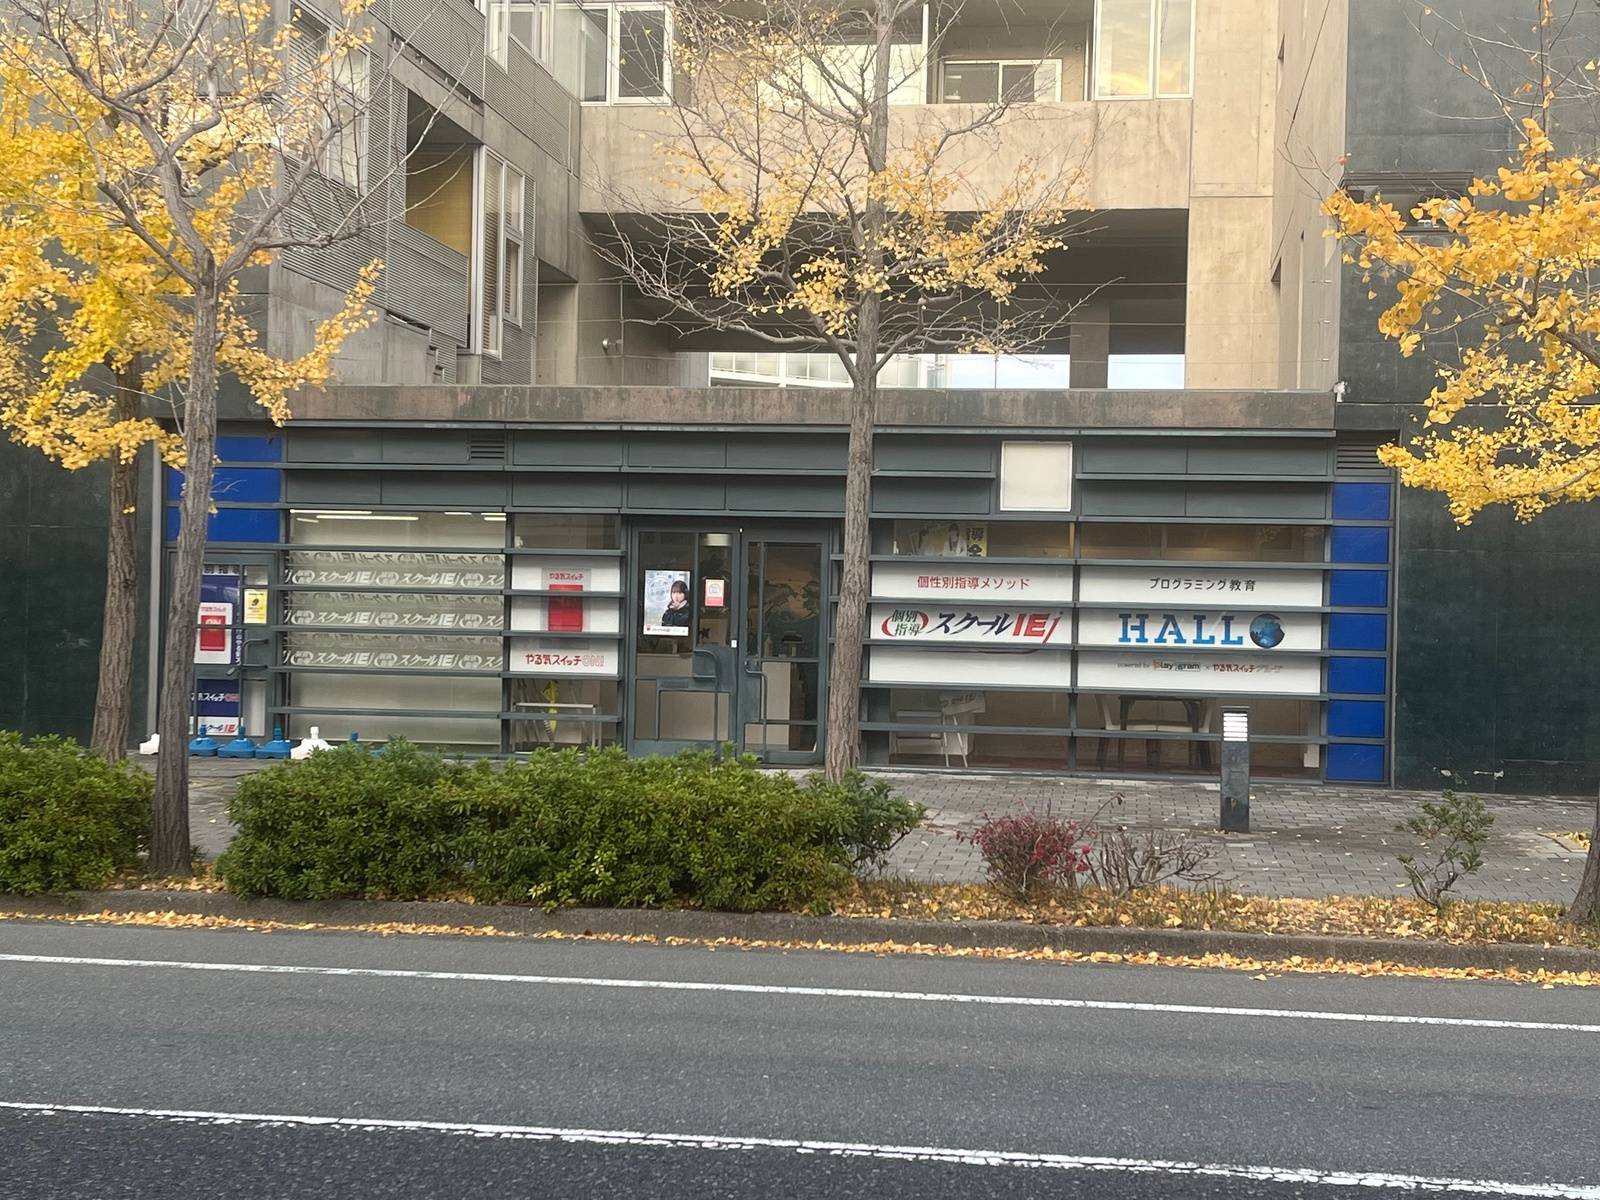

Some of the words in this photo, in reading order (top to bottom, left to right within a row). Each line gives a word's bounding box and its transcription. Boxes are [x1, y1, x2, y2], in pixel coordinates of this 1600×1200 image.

[917, 575, 1030, 590] 個性別指導メソッド
[1150, 578, 1257, 592] プログラミング教育
[892, 609, 918, 623] 個別
[894, 623, 920, 637] 指導
